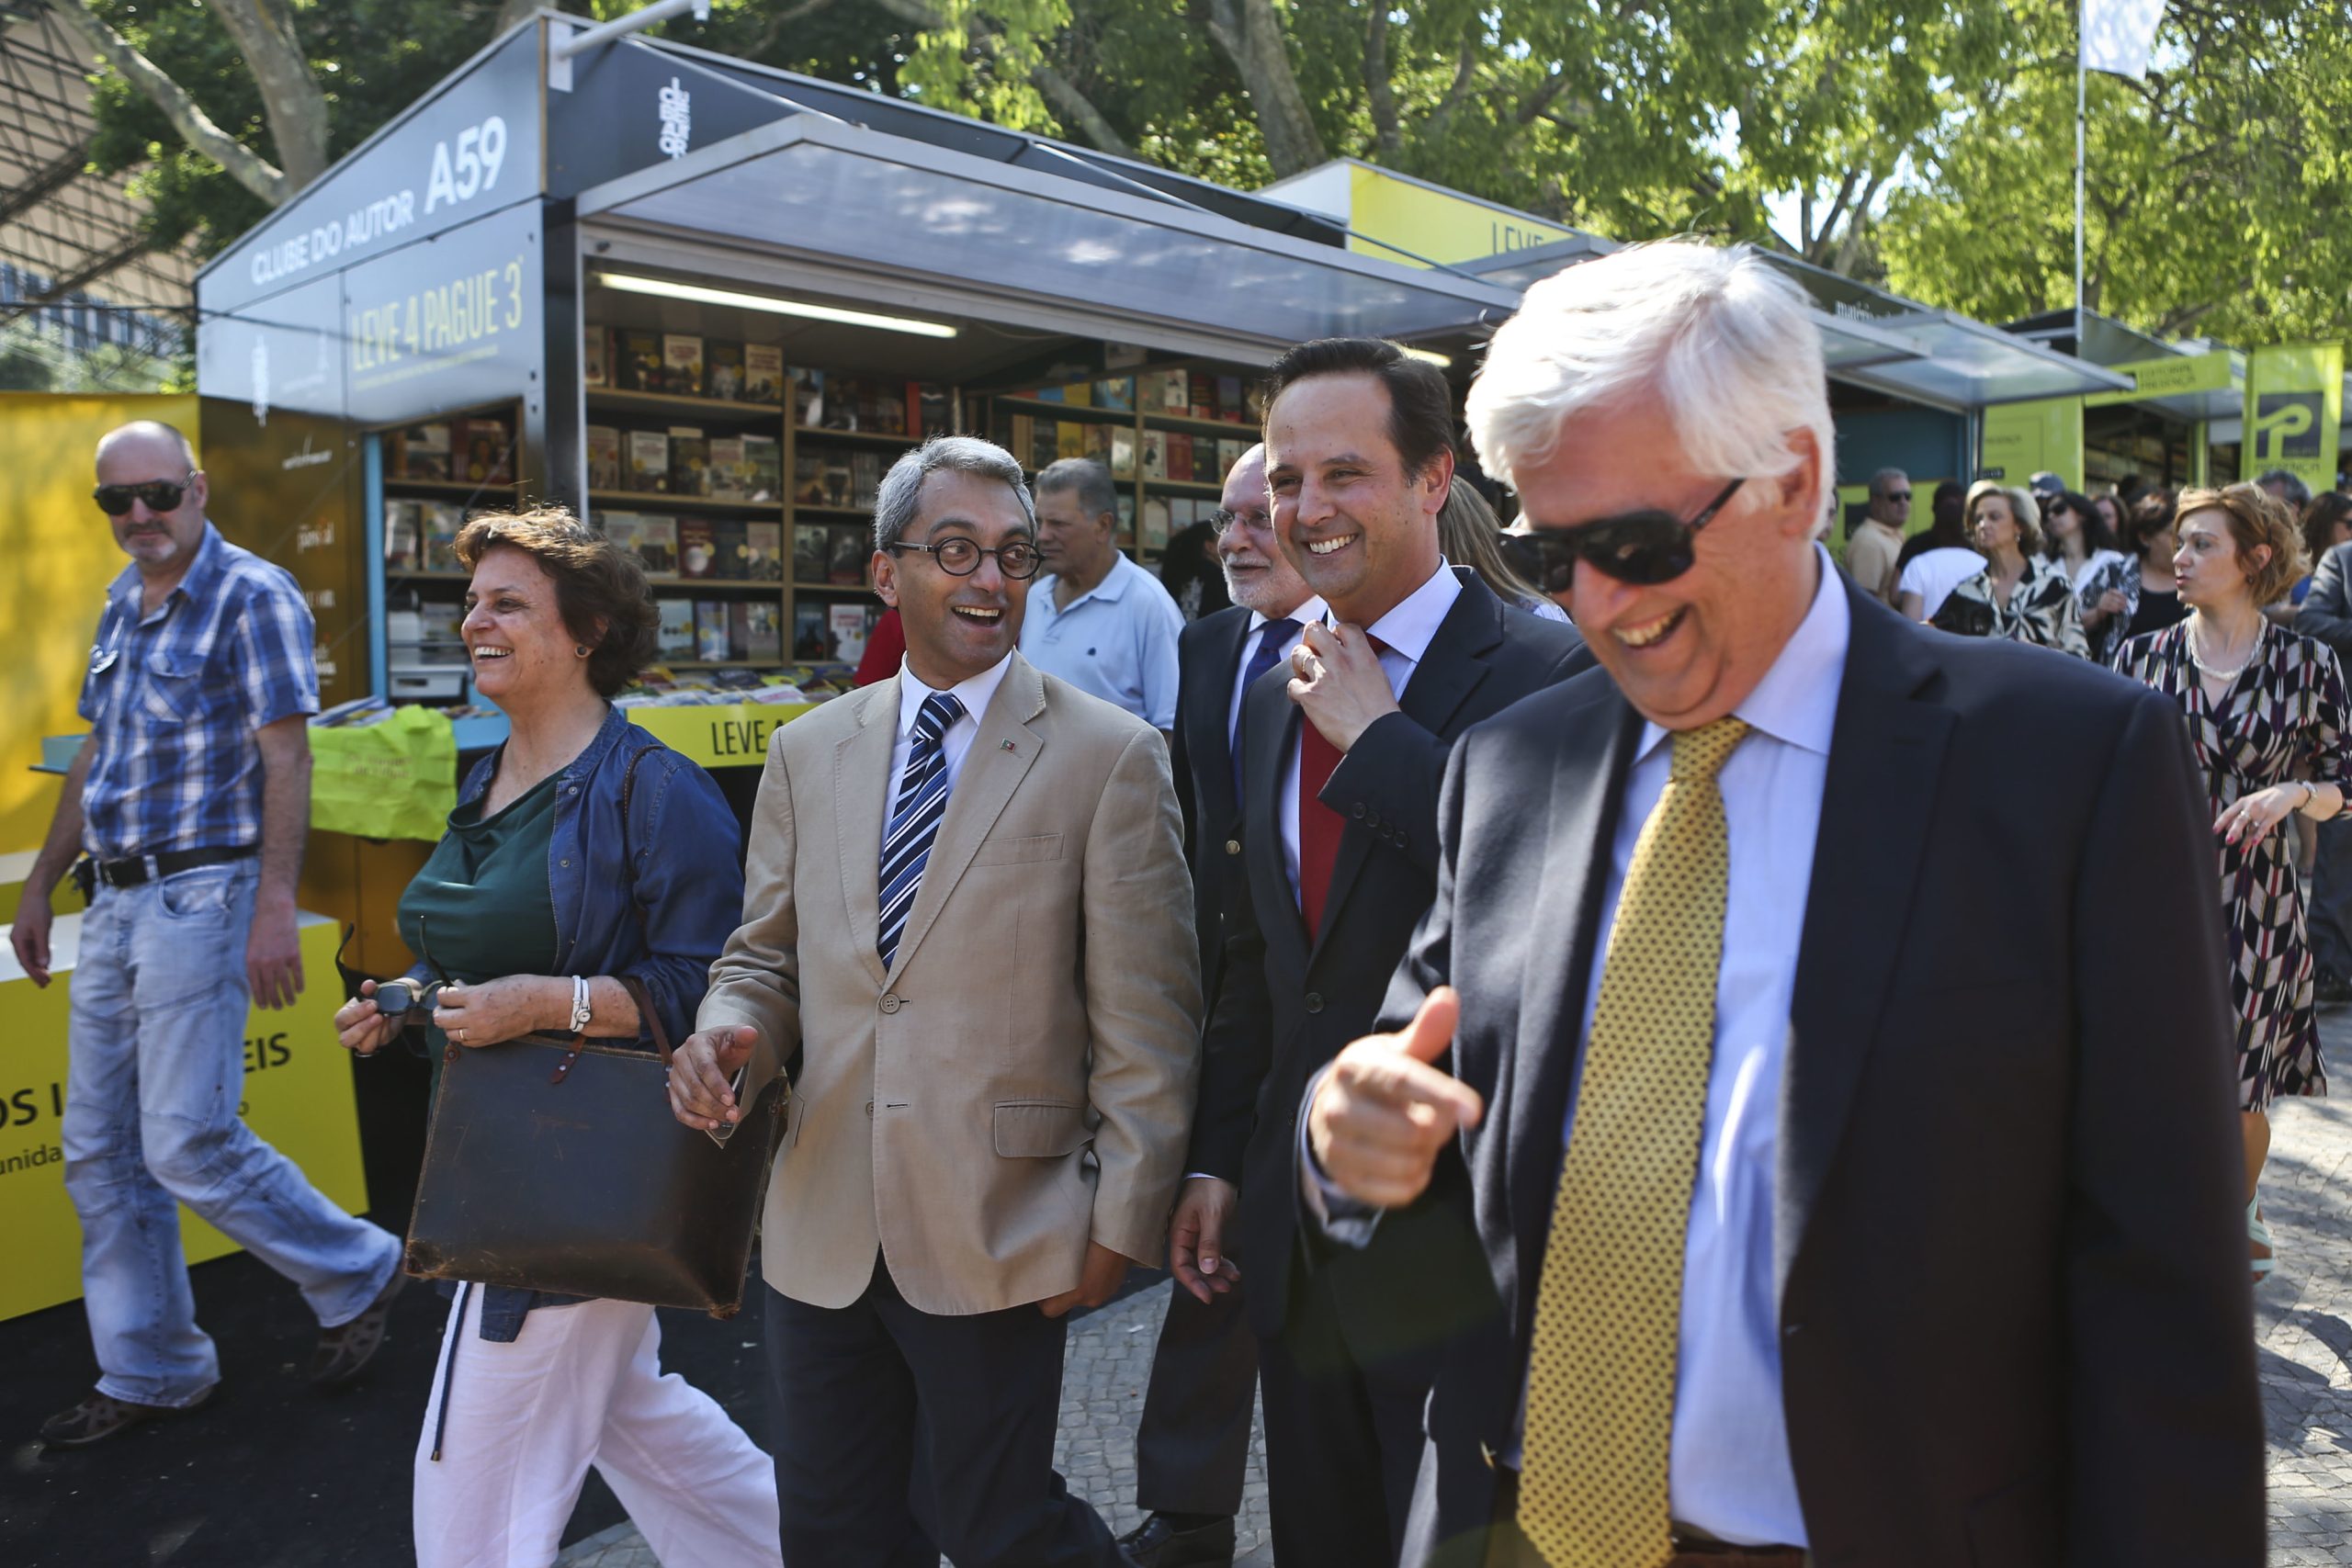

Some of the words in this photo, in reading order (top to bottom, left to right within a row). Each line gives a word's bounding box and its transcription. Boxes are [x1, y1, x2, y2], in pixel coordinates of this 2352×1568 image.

[250, 232, 310, 287] CLUBE
[311, 220, 343, 264] DO
[344, 188, 414, 250] AUTOR
[423, 115, 508, 216] A59
[351, 301, 402, 372] LEVE
[404, 295, 419, 355] 4
[423, 269, 500, 352] PAGUE
[711, 719, 767, 756] LEVE
